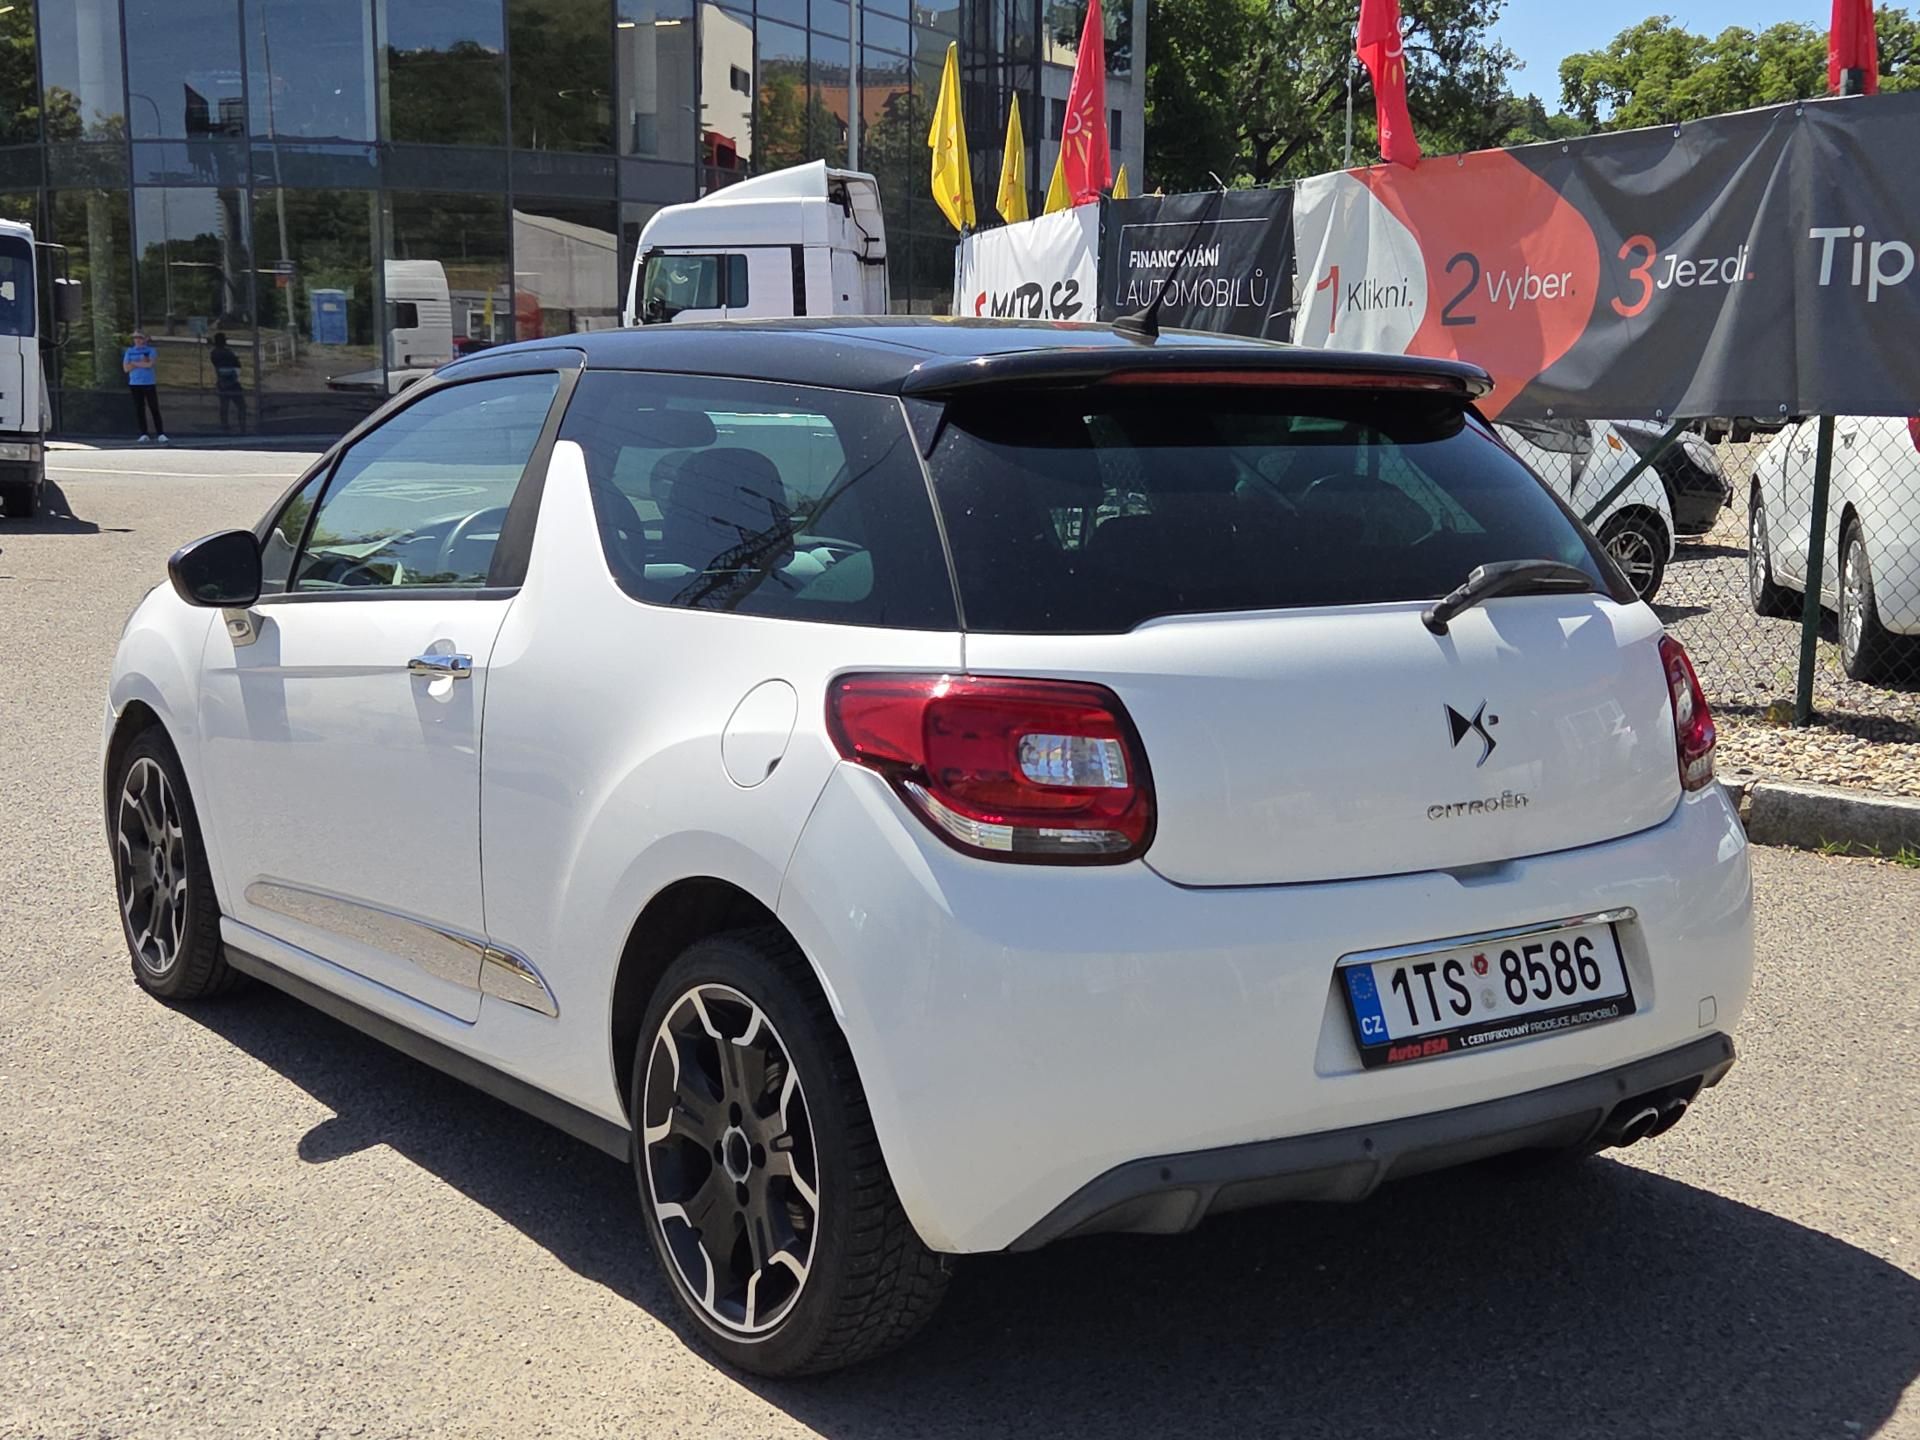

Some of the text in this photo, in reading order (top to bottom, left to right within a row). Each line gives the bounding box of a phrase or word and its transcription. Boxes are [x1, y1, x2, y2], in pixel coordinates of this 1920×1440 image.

[1128, 243, 1220, 268] FINANCOVÁNÍ
[1611, 234, 1755, 318] 3 Jezdi.
[1126, 268, 1269, 308] AUTOMOBILŮ
[1316, 265, 1413, 334] 1 Klikni.
[1441, 252, 1576, 326] 2 Vyber.
[1391, 936, 1601, 1027] 1TS 8586
[1361, 1014, 1384, 1036] CZ
[1387, 1037, 1449, 1063] Auto ESA
